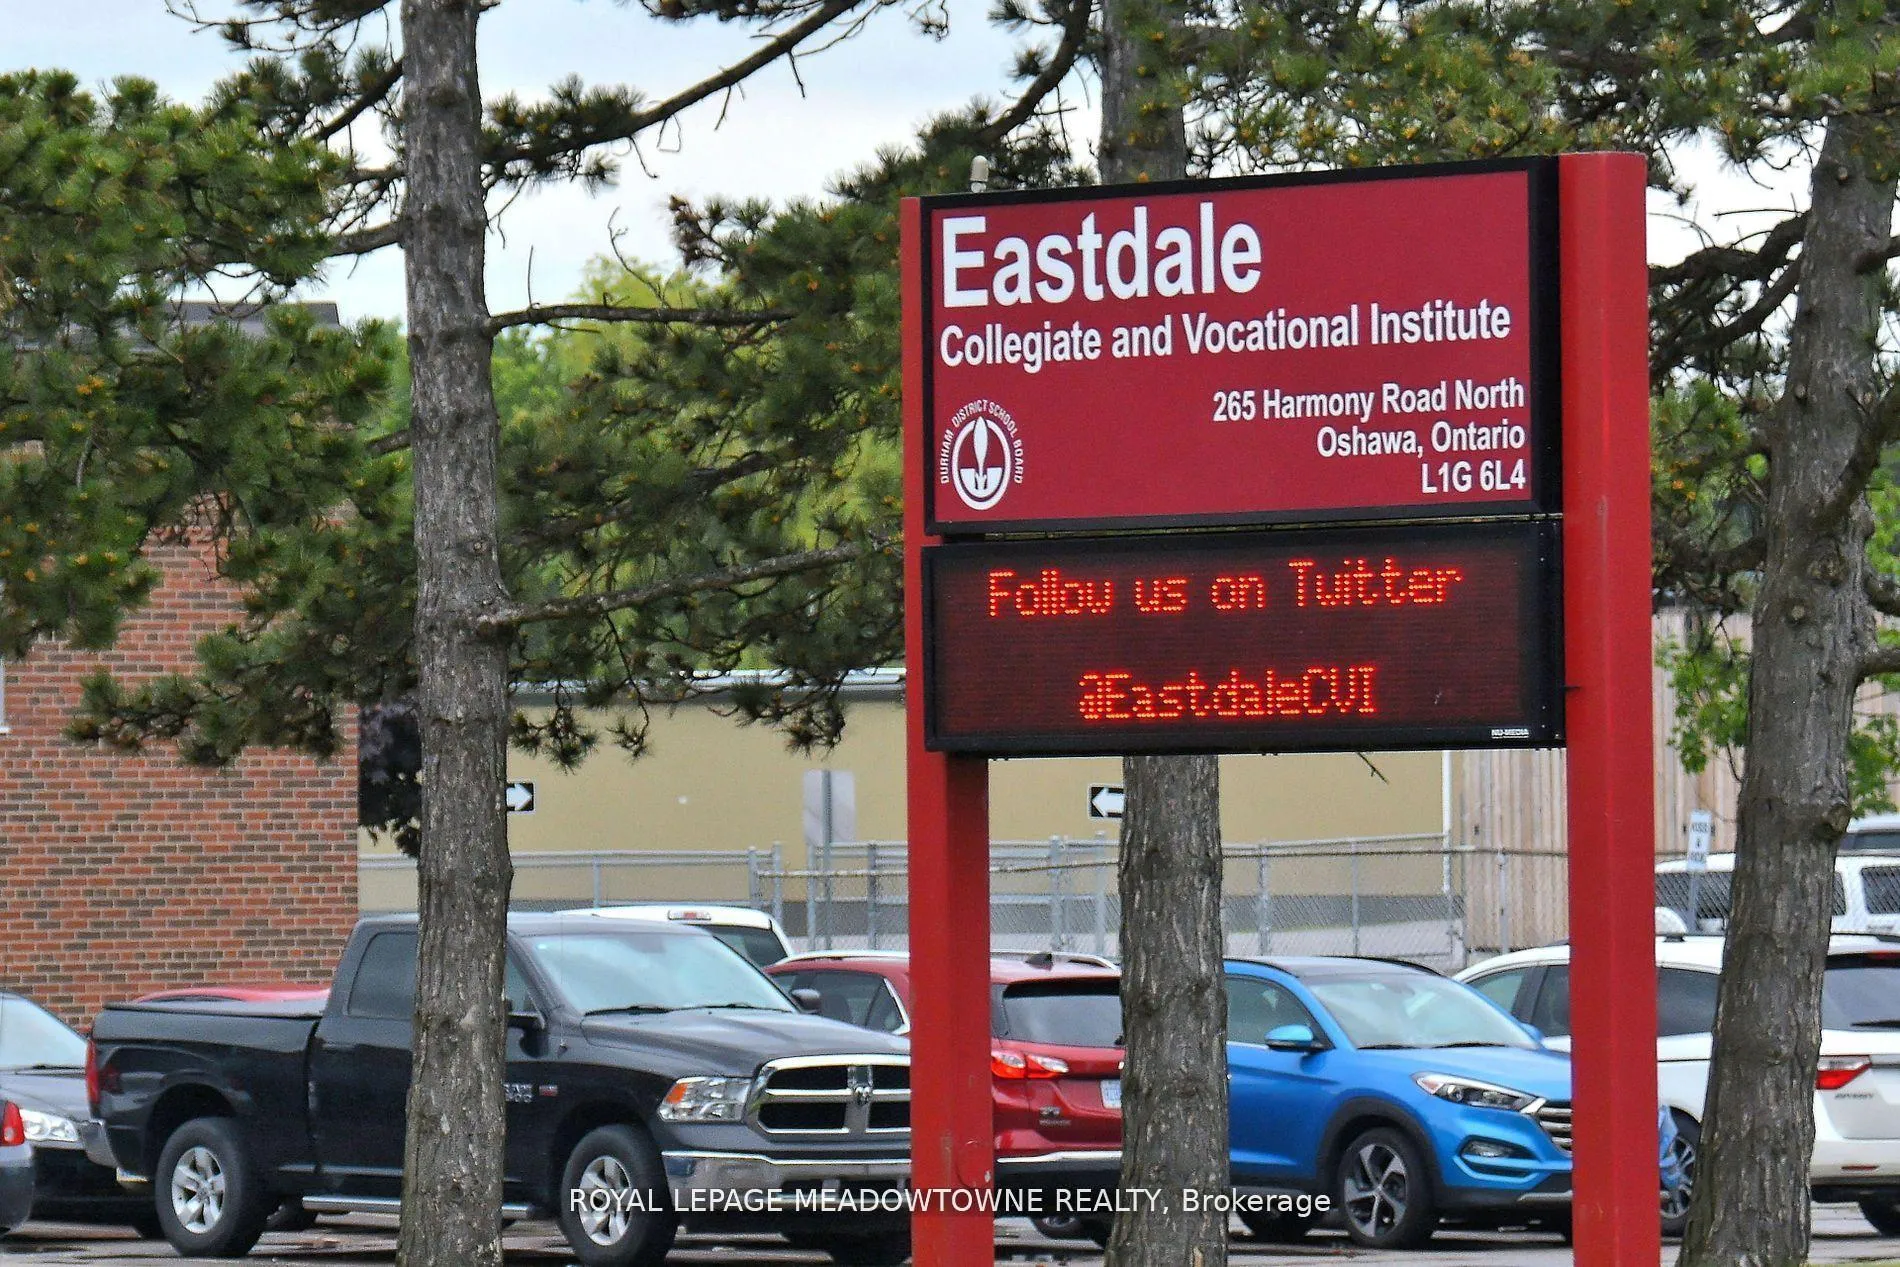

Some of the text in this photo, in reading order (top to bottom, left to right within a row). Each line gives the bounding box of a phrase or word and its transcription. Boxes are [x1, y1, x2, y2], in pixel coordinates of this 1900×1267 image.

[942, 201, 1262, 308] Eastdale
[940, 298, 1511, 374] Collegiate and Vocational Institute
[1212, 376, 1525, 424] 265 Harmony Road North
[940, 399, 1024, 484] DURHAM DISTRICT SCHOOL BOARD
[1316, 418, 1526, 459] Oshawa, Ontario
[1421, 458, 1526, 494] L1G 6L4
[988, 557, 1464, 618] Follow us on Twitter
[1077, 665, 1378, 721] @EastdaleCVI
